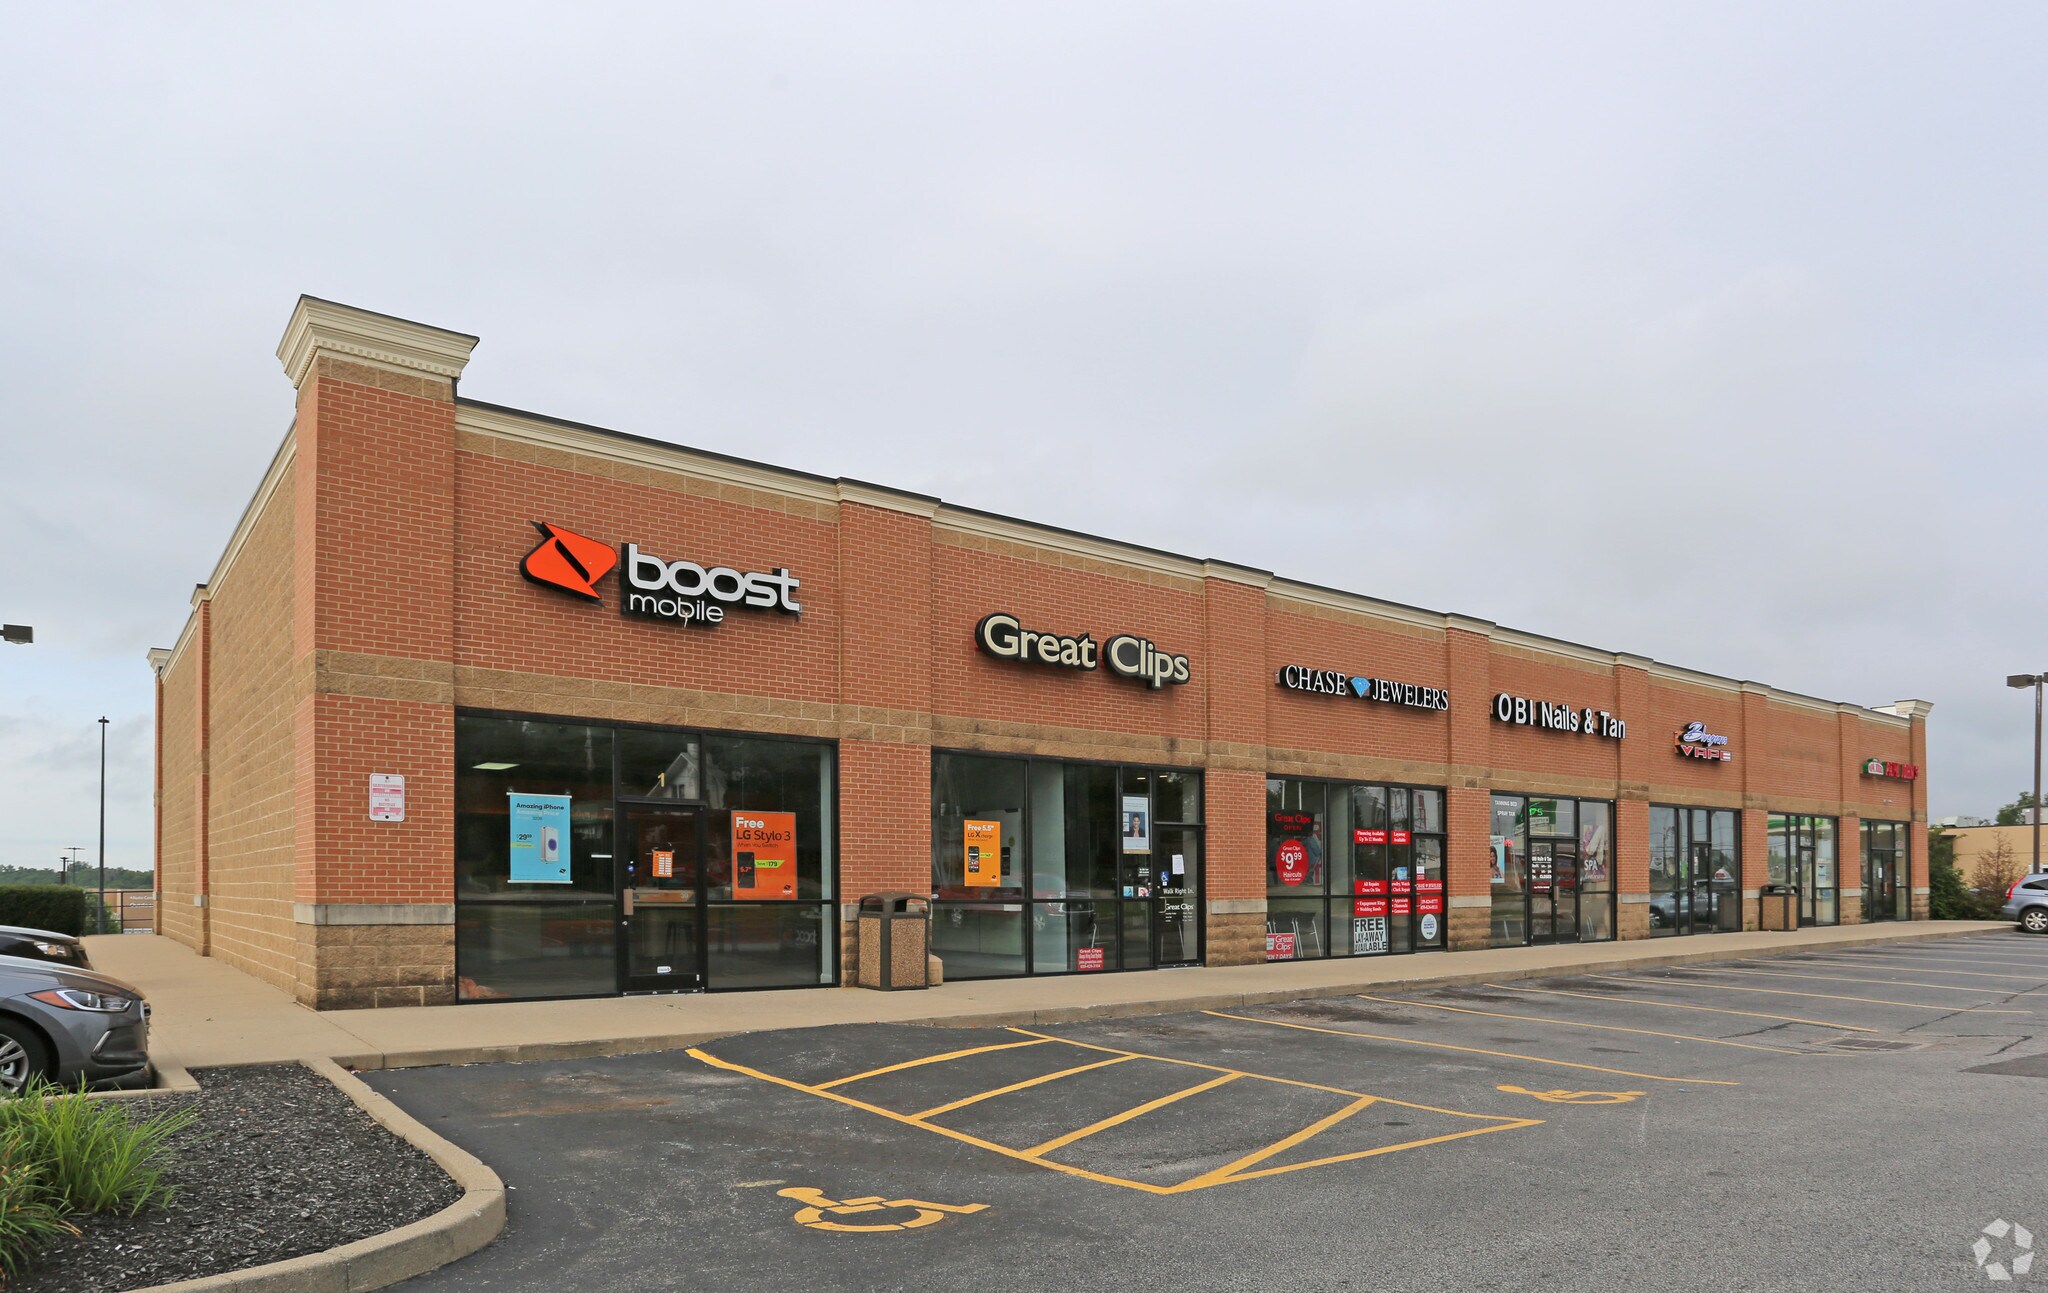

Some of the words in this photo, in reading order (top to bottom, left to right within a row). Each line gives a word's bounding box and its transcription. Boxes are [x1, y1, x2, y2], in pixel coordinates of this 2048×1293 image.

[628, 542, 800, 611] boost
[630, 593, 724, 622] mobile
[984, 615, 1096, 668] Great
[1111, 636, 1189, 687] Clips
[1285, 664, 1347, 696] CHASE
[1372, 678, 1449, 711] JEWELERS
[1541, 701, 1579, 733] Nails
[1584, 708, 1595, 734] &
[1600, 711, 1627, 739] Tan
[1680, 744, 1732, 762] VAPE
[657, 772, 665, 788] 1
[516, 802, 543, 811] Amazing
[735, 816, 764, 829] Free
[736, 830, 751, 840] LG
[754, 830, 782, 843] Stylo
[784, 831, 791, 841] 3
[1584, 859, 1598, 871] SPA
[1354, 918, 1384, 932] FREE
[1275, 935, 1293, 943] Great
[1276, 942, 1292, 952] Clips
[1355, 941, 1387, 952] AVAILABLE
